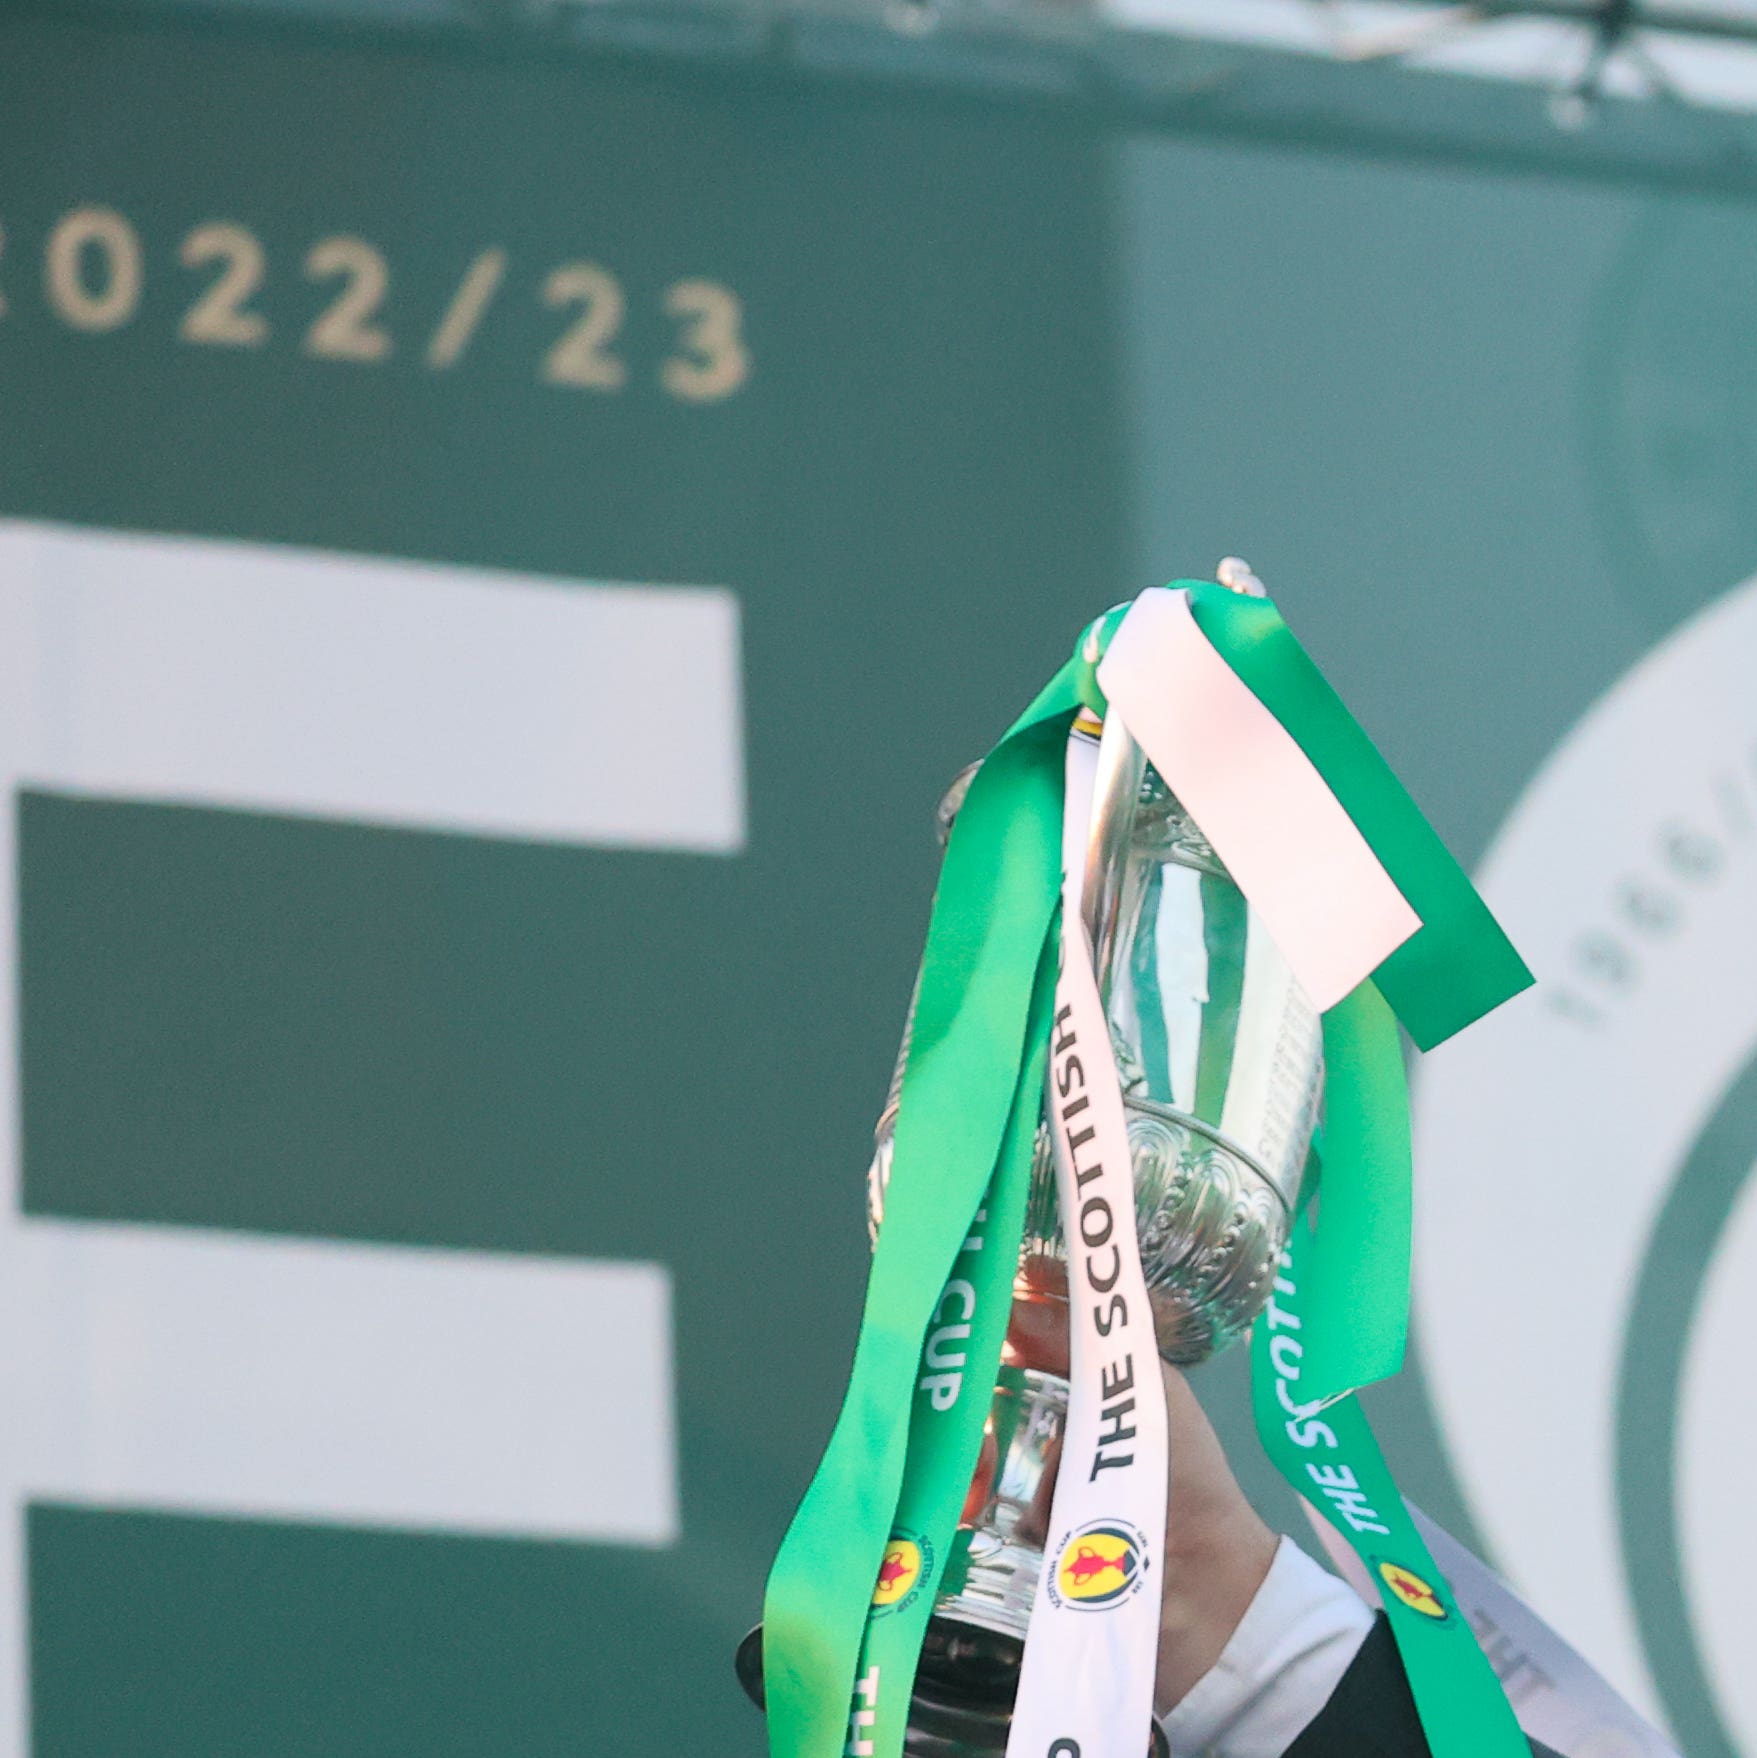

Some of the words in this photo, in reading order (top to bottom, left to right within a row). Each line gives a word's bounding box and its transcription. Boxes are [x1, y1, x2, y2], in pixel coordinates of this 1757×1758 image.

[0, 205, 753, 403] 022/23
[1053, 1003, 1130, 1338] SCOTTISH
[919, 1279, 977, 1412] CUP
[1089, 1353, 1137, 1483] THE
[1305, 1462, 1391, 1537] THE
